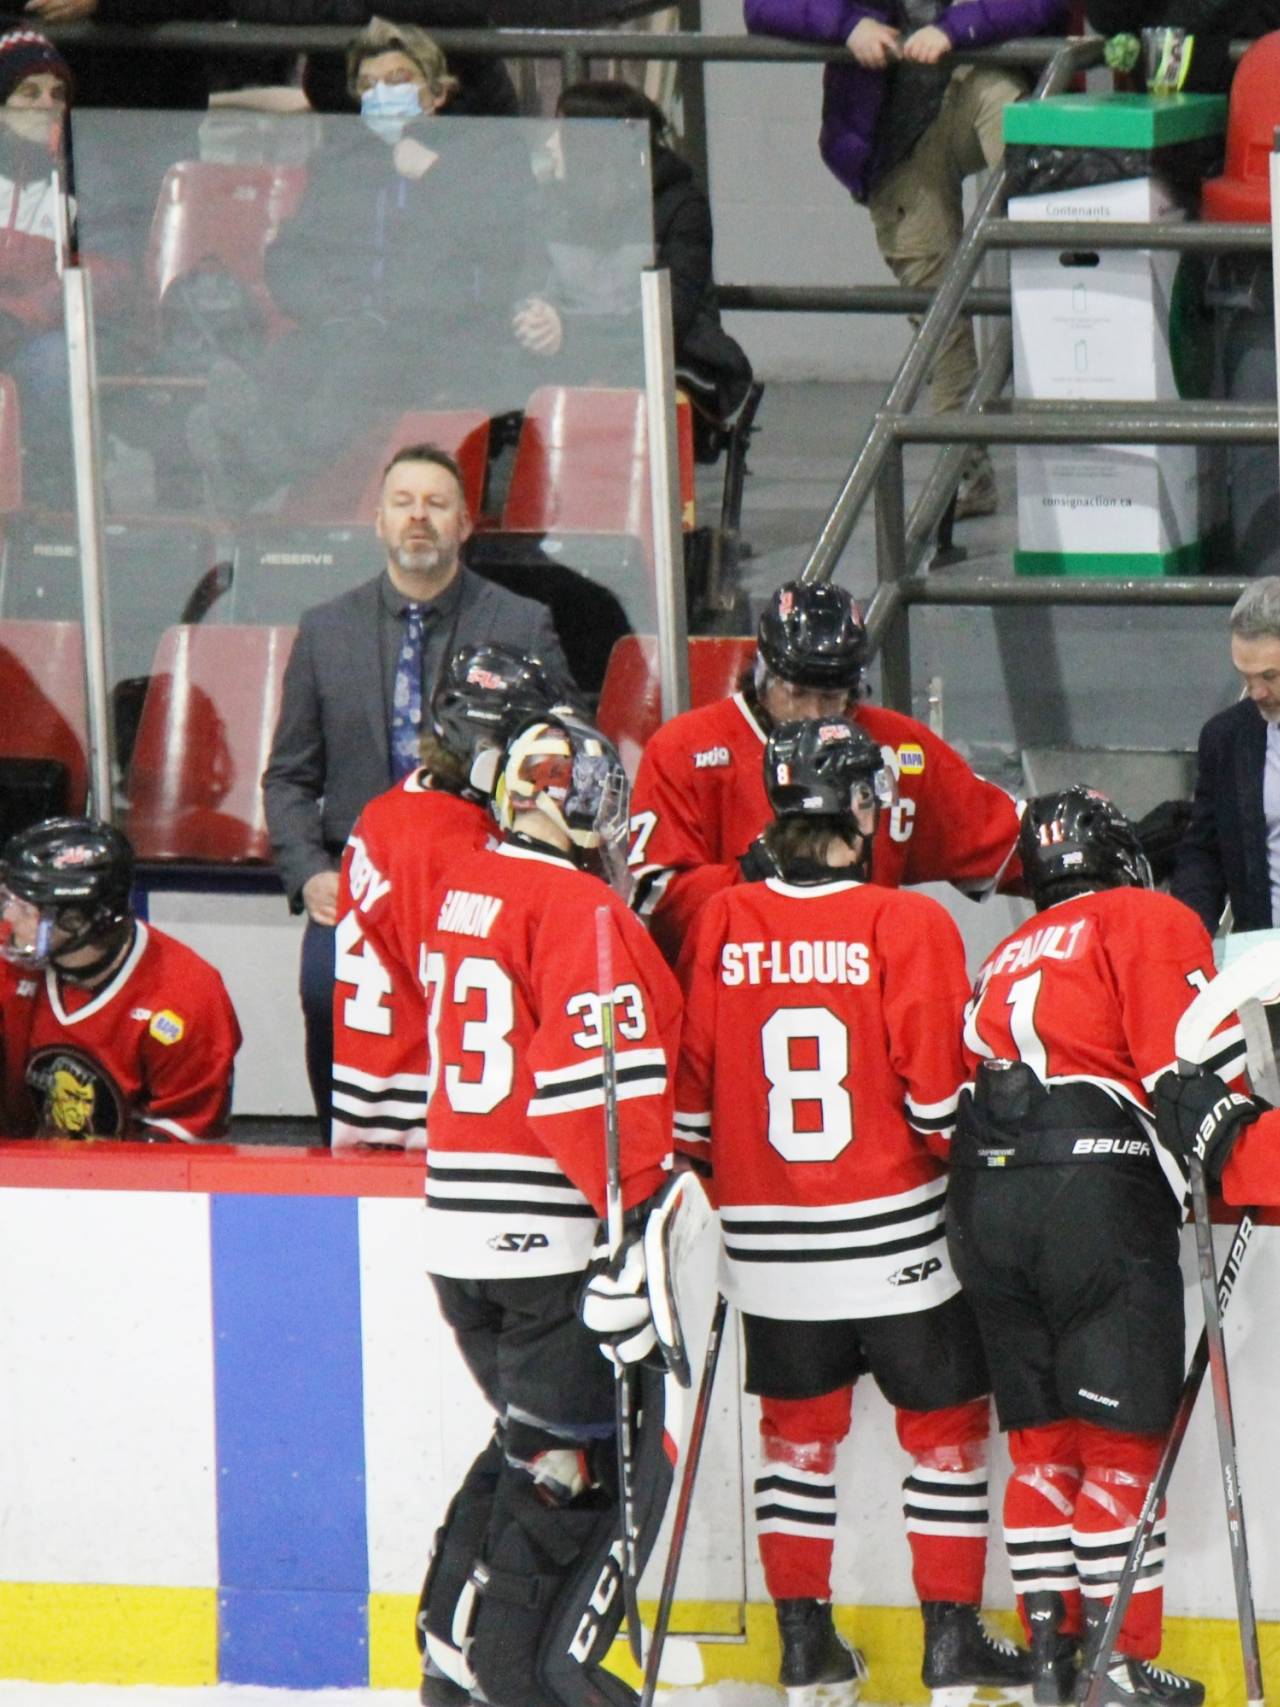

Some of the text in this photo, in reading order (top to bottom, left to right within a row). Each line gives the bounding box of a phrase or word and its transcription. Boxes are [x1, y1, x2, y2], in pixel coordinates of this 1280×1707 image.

[901, 753, 922, 765] NAPA
[777, 763, 789, 786] 8
[890, 798, 915, 843] C
[1039, 820, 1064, 846] 11
[721, 940, 871, 986] ST-LOUIS
[565, 983, 647, 1049] 33
[761, 1007, 853, 1162] 8
[1072, 1138, 1151, 1156] BAUER
[497, 1233, 549, 1252] SP
[898, 1257, 943, 1286] SP
[1078, 1388, 1120, 1408] BAUER
